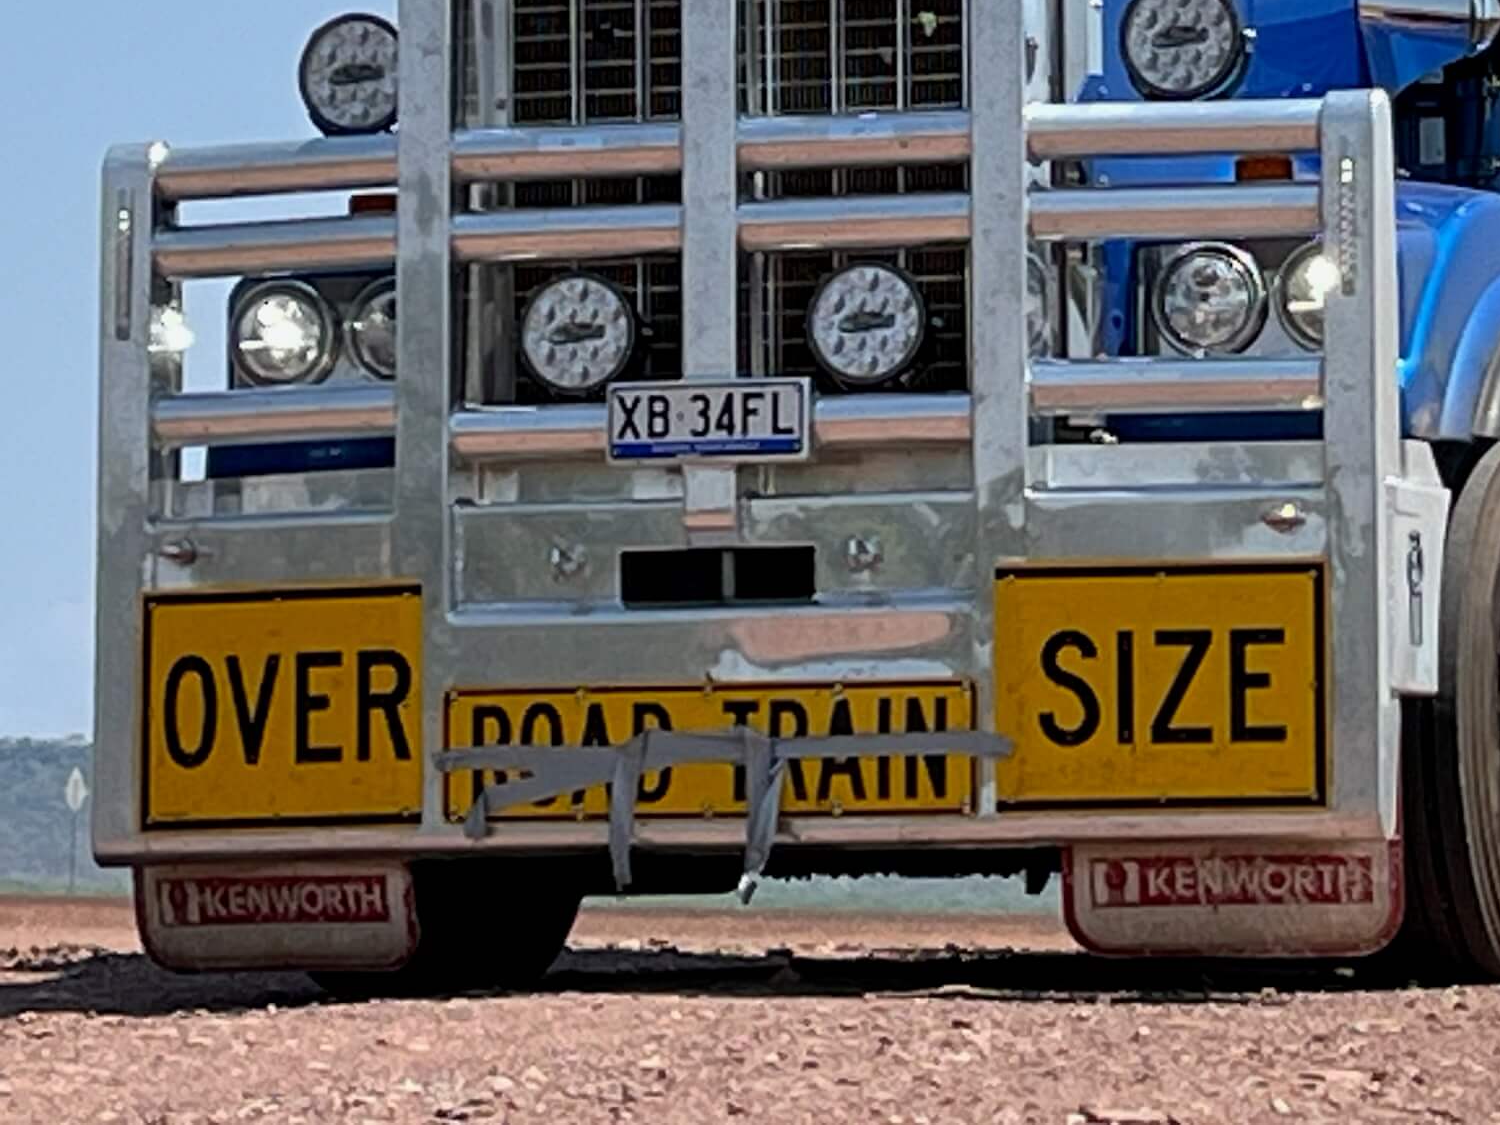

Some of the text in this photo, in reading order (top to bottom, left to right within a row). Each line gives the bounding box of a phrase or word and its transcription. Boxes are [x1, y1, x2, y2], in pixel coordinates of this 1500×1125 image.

[164, 649, 412, 769] OVER
[1038, 628, 1287, 747] SIZE
[723, 696, 947, 802] TRAIN
[203, 881, 385, 919] KENWORTH
[1147, 859, 1369, 902] KENWORTH
